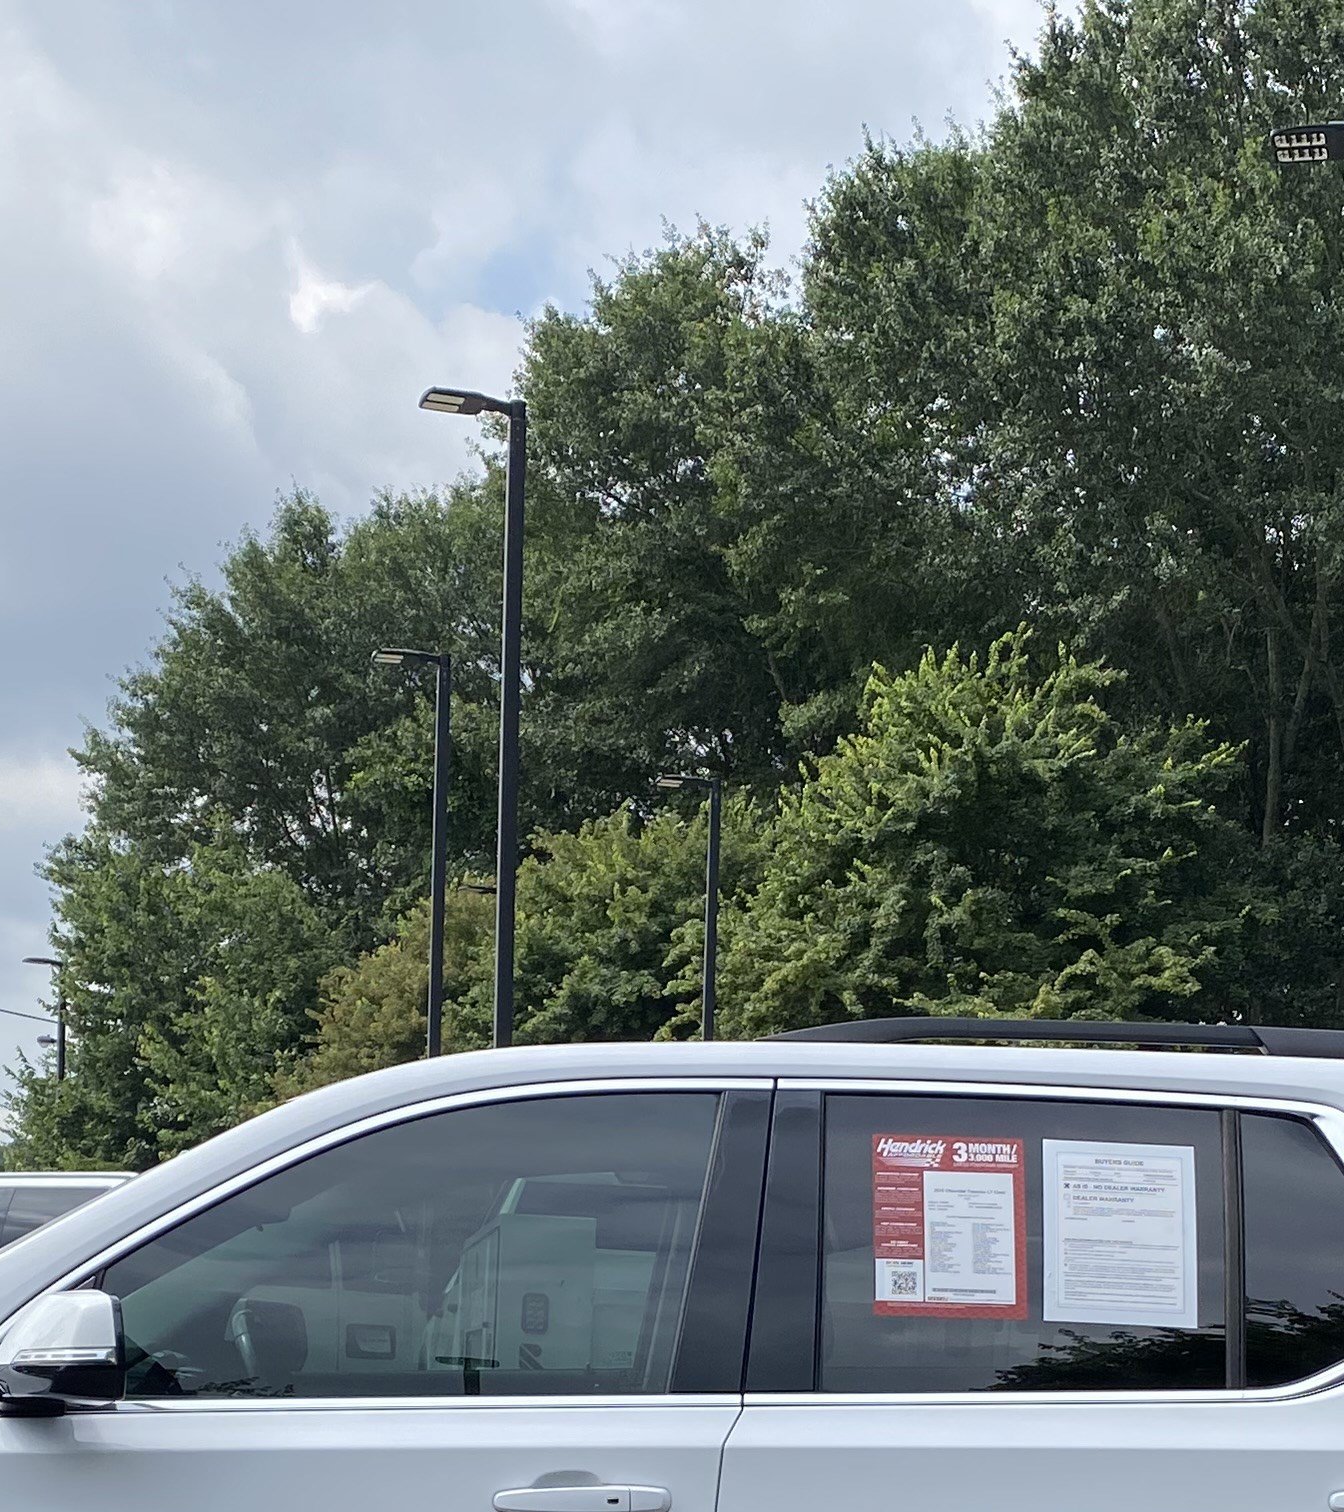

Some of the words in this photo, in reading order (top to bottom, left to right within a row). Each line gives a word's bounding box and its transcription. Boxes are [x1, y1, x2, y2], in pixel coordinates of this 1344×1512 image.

[877, 1138, 946, 1157] Hendrick
[952, 1142, 968, 1162] 3
[968, 1143, 1017, 1154] MONTH/
[995, 1154, 1017, 1163] MILE
